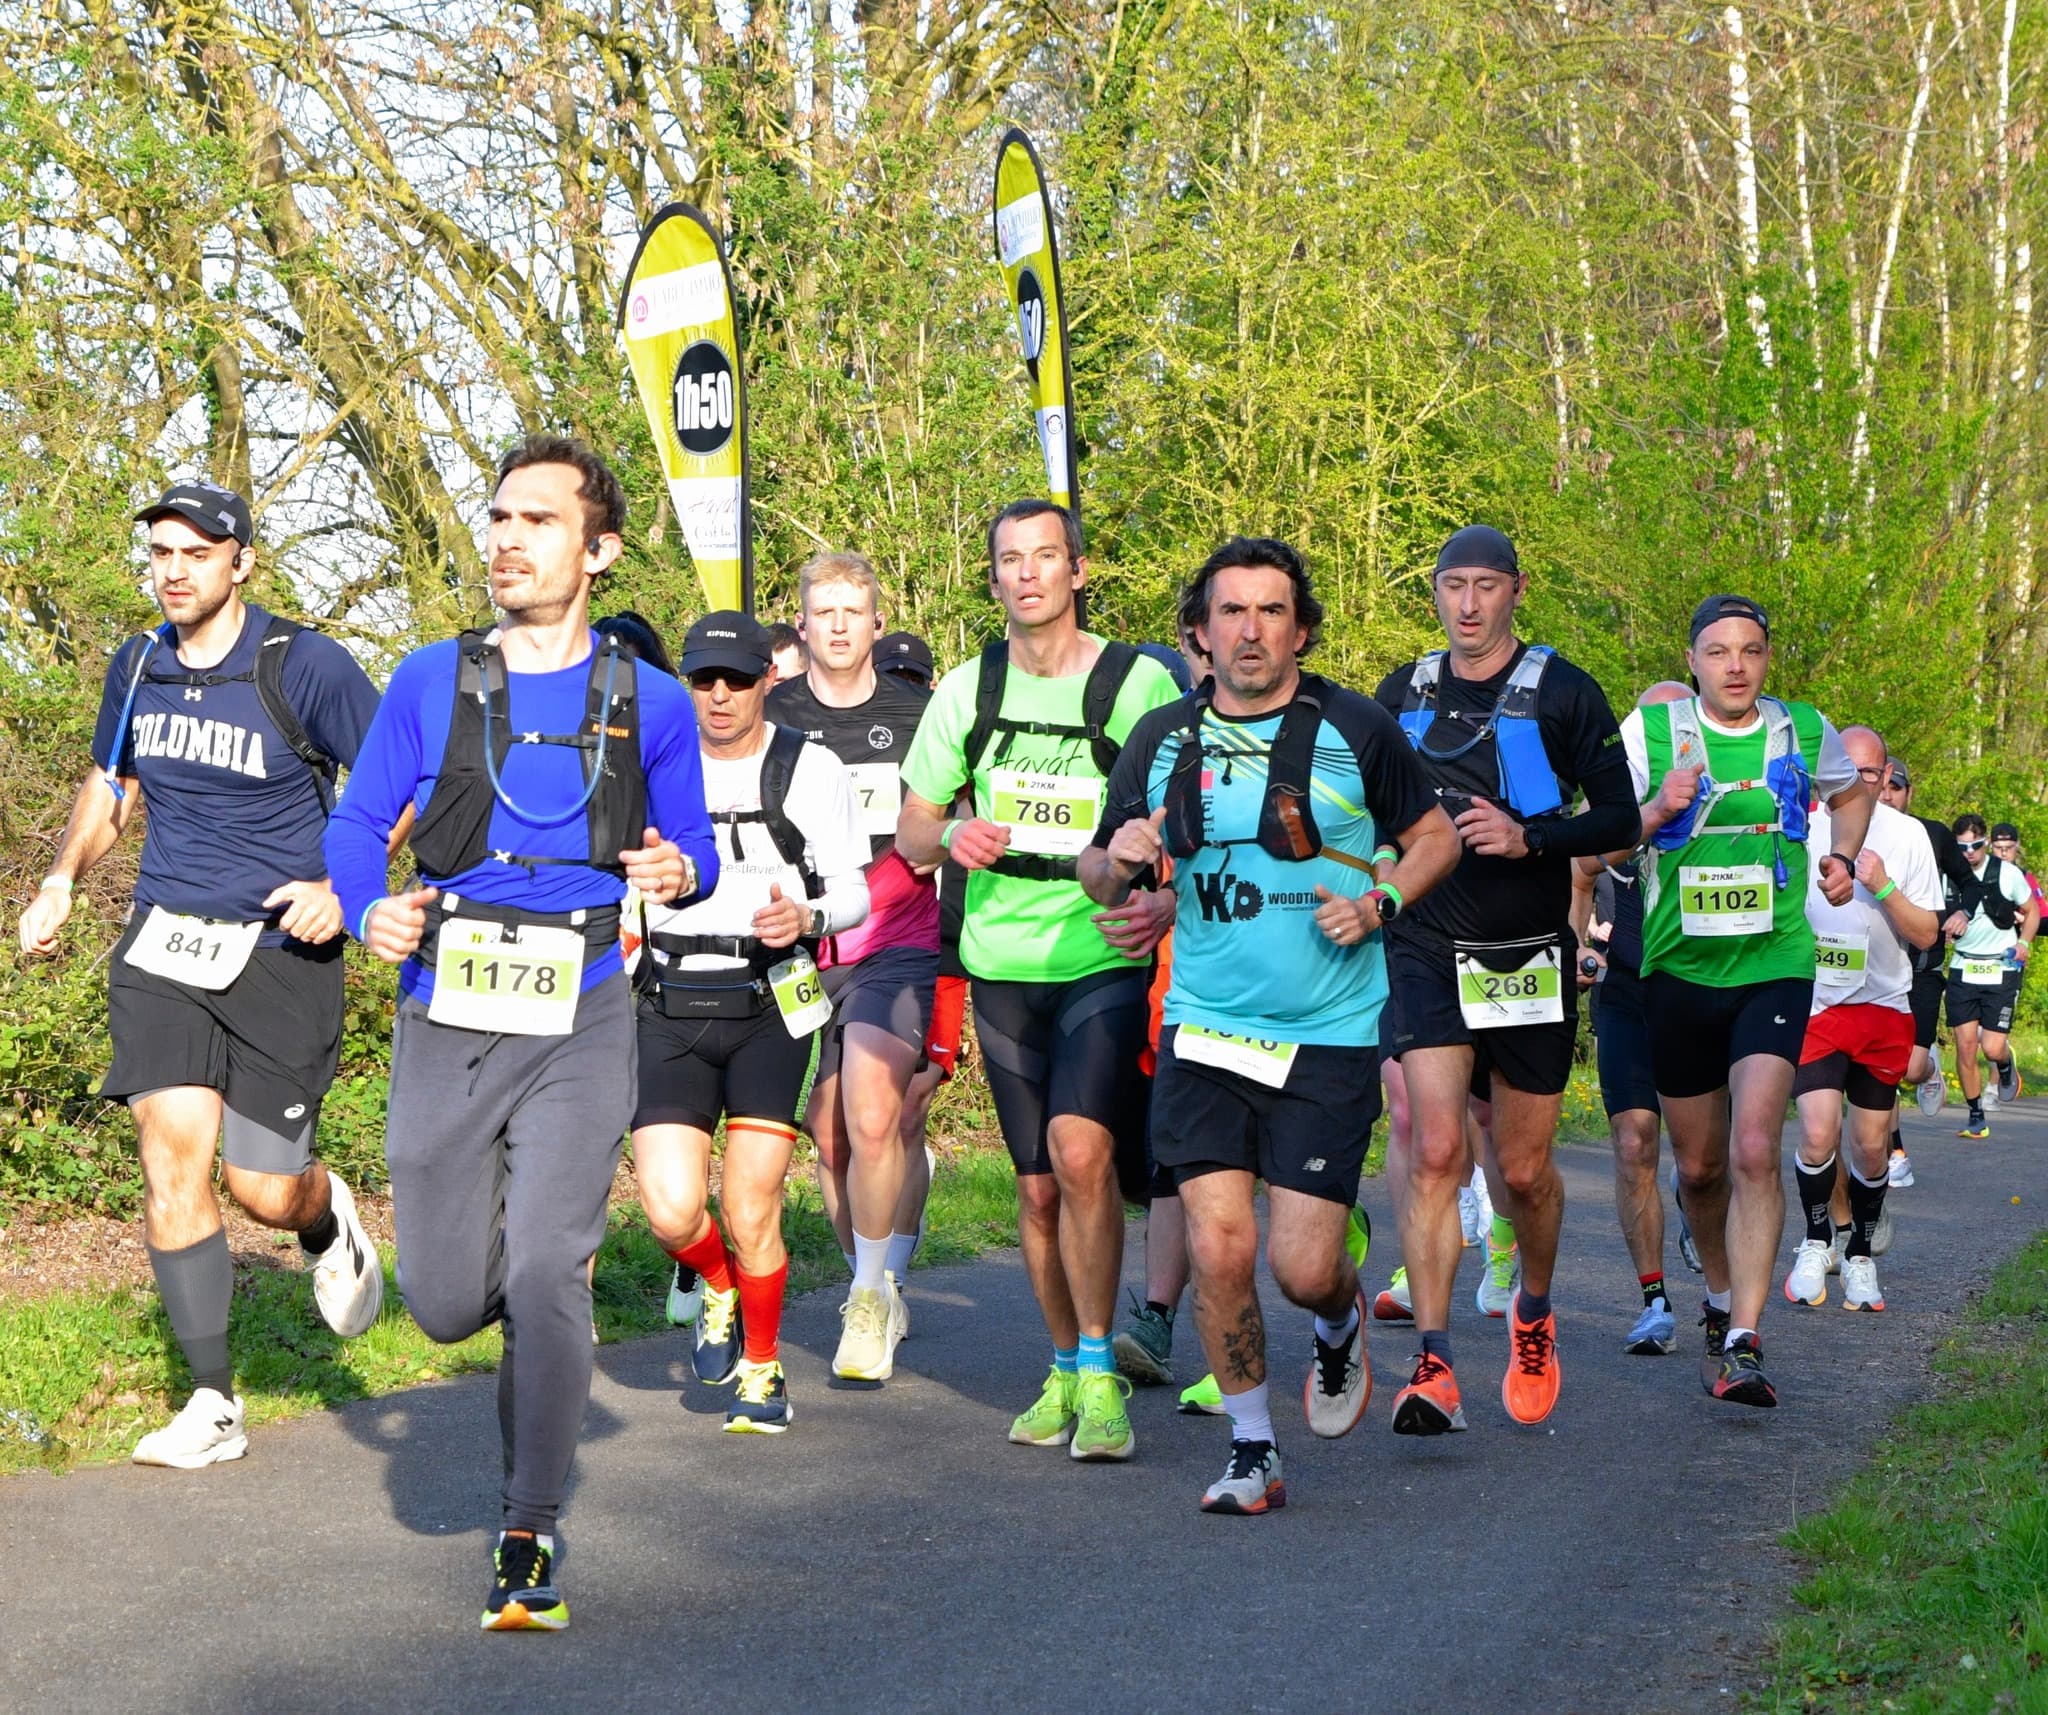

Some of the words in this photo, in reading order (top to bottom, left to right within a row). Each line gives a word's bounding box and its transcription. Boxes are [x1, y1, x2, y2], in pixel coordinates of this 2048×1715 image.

[675, 370, 732, 431] 1h50
[707, 630, 736, 638] KIPRUN
[592, 723, 629, 738] KPRUN
[133, 713, 267, 779] COLUMBIA
[1016, 799, 1071, 825] 786
[1693, 889, 1758, 910] 1102
[165, 932, 222, 962] 841
[459, 958, 556, 995] 1178
[1972, 965, 1993, 974] 555
[1484, 974, 1538, 998] 268
